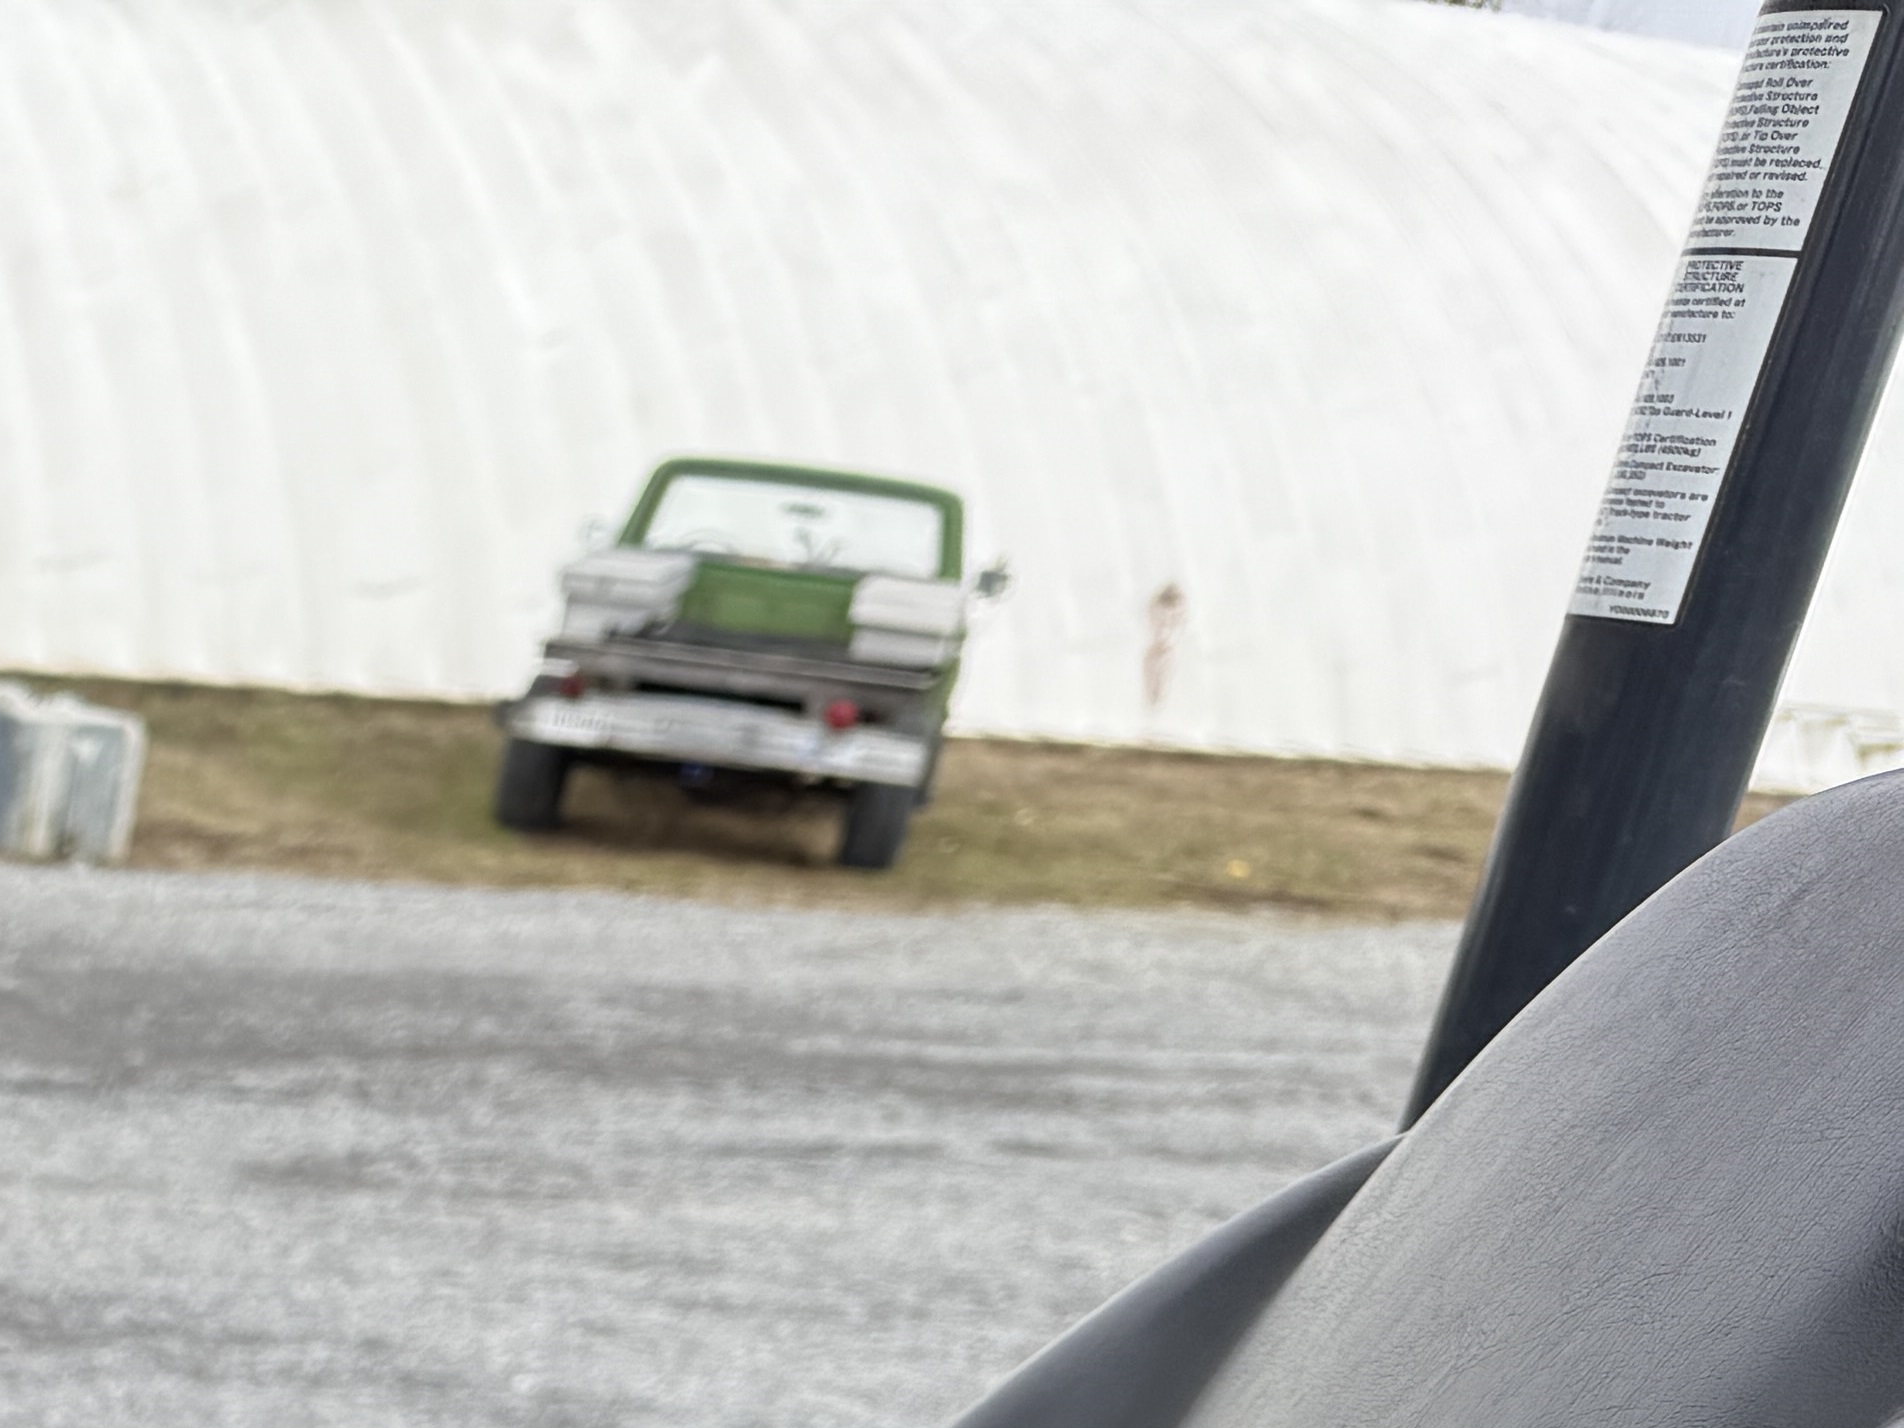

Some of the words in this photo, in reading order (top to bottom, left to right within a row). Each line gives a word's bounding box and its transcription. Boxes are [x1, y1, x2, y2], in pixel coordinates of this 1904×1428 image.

[1825, 34, 1849, 44] and
[1791, 46, 1850, 56] protective
[1786, 78, 1813, 88] Over
[1766, 92, 1818, 101] Structure
[1781, 104, 1820, 115] Object
[1757, 118, 1809, 128] Structure
[1771, 131, 1798, 141] Over
[1748, 144, 1800, 154] Structure
[1766, 189, 1784, 199] the
[1751, 201, 1783, 212] TOPS
[1763, 215, 1778, 227] by
[1781, 216, 1800, 226] the
[1689, 492, 1709, 502] are
[1603, 576, 1651, 590] Company
